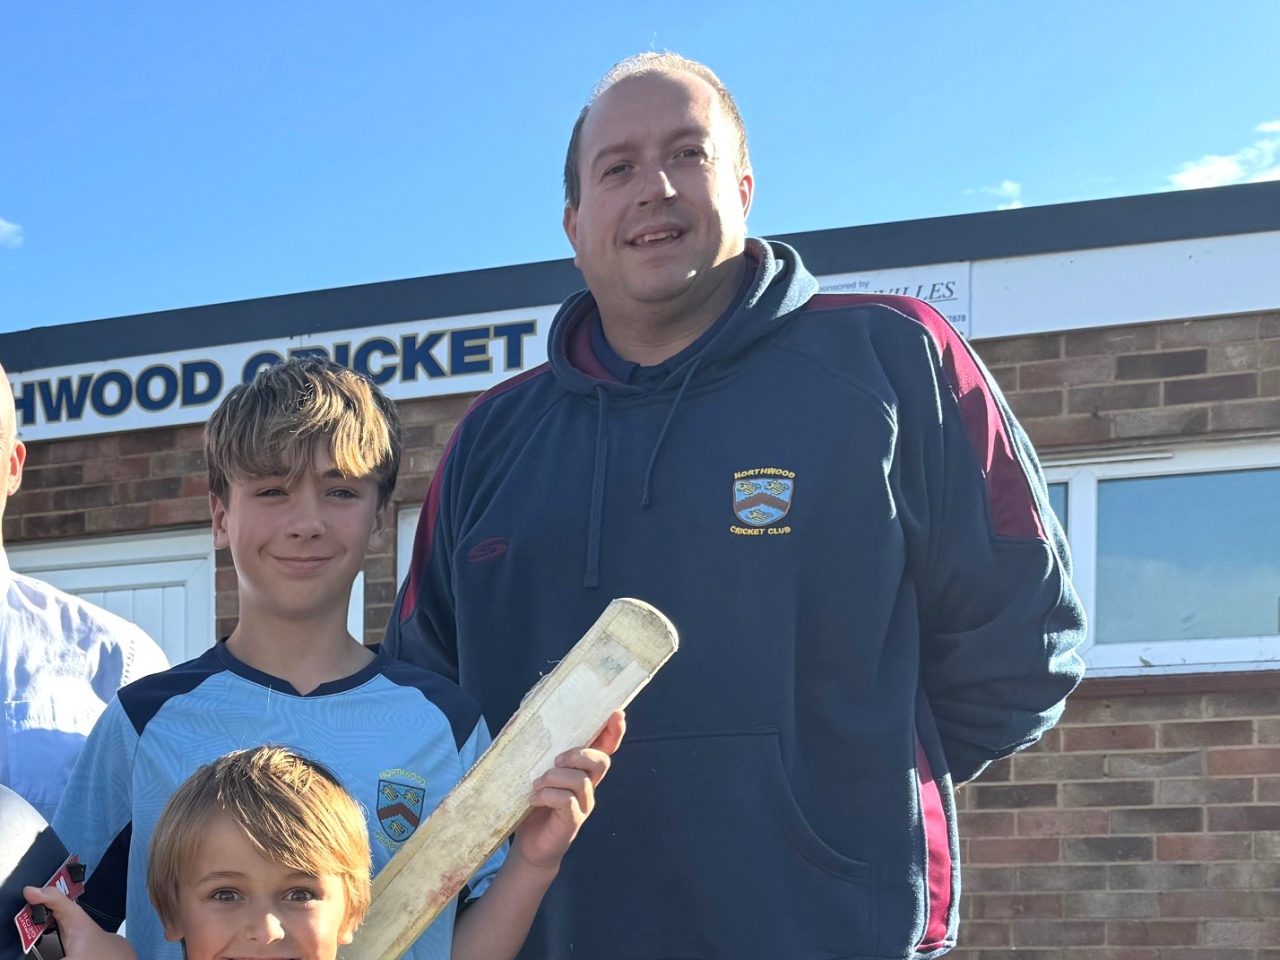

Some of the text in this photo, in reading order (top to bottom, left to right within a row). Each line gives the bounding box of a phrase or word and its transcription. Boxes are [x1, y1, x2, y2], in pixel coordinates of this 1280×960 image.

[241, 318, 537, 386] CICKET
[734, 467, 795, 479] NORTHWOOD
[730, 525, 791, 535] CRICKET CLUB
